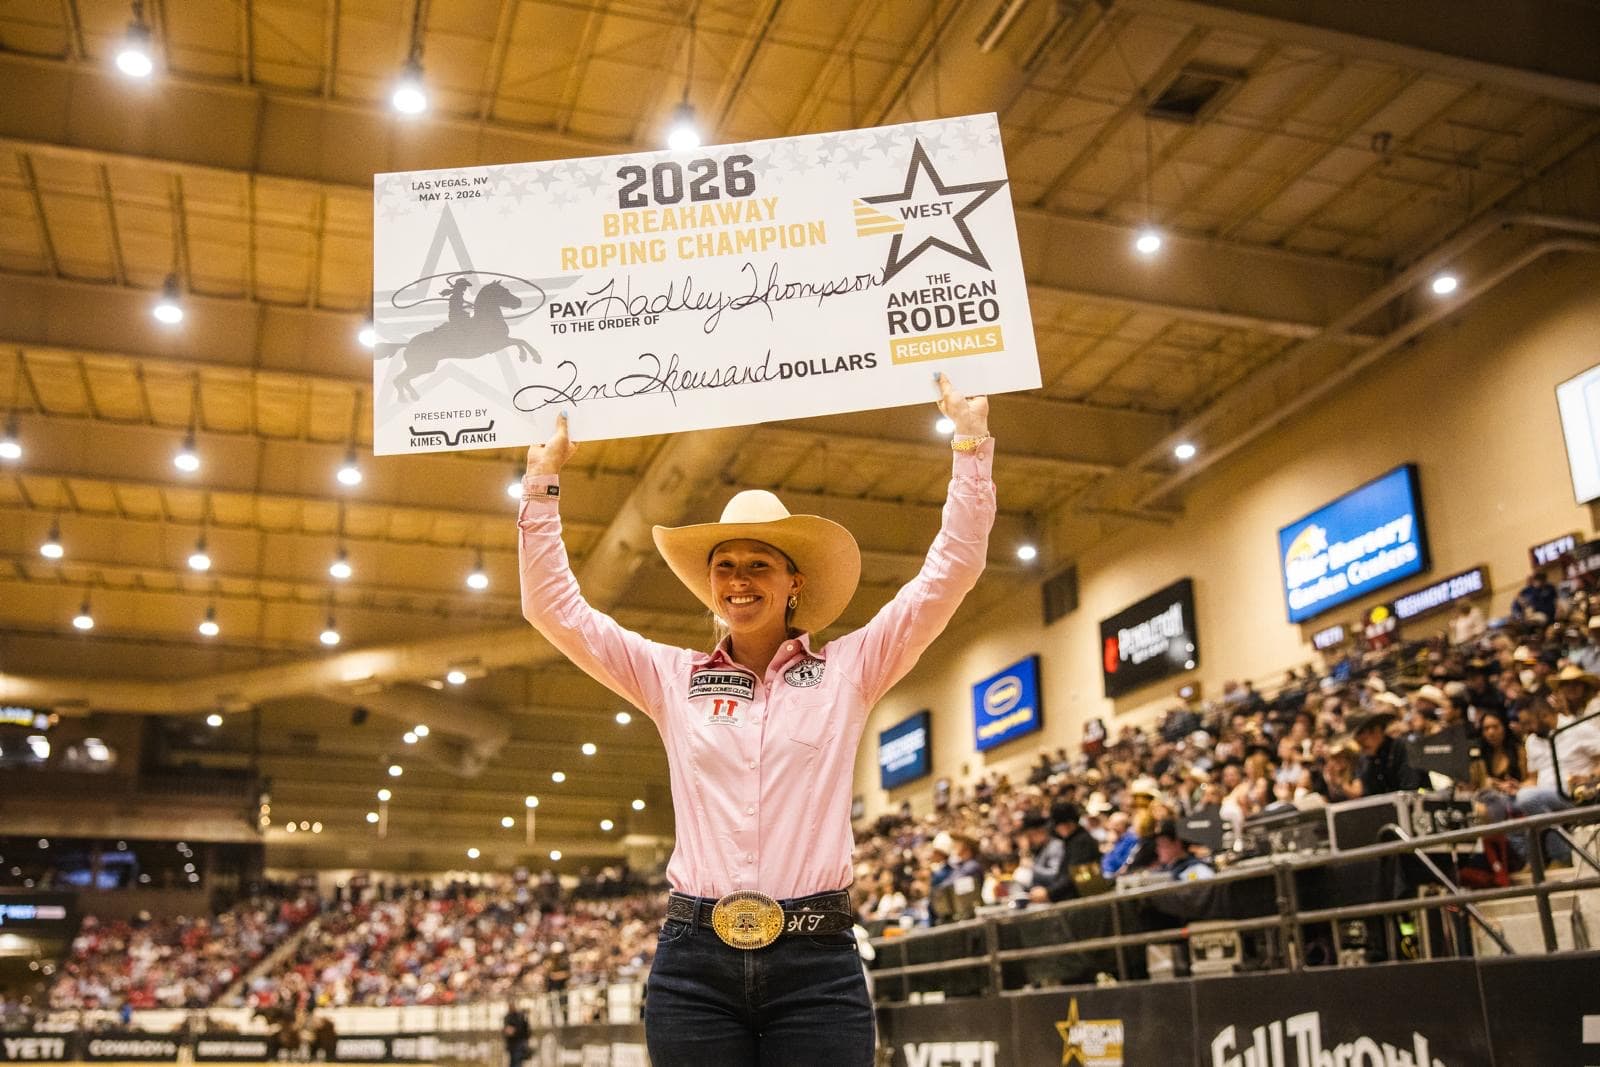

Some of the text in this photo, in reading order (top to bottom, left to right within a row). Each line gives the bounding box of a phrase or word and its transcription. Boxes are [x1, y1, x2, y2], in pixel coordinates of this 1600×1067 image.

[412, 177, 488, 191] LAS VEGAS, NV
[616, 154, 756, 209] 2026
[419, 190, 481, 202] MAY 2, 2026
[602, 196, 779, 238] BREAKAWAY
[900, 201, 954, 220] WEST
[561, 219, 828, 271] ROPING CHAMPION
[926, 272, 951, 285] THE
[587, 262, 886, 334] Hadley Thompson
[887, 279, 997, 309] AMERICAN
[550, 300, 588, 319] PAY
[887, 298, 1001, 335] RODEO
[551, 314, 660, 334] TO THE ORDER OF
[895, 332, 998, 359] REGIONALS
[779, 352, 878, 380] DOLLARS
[513, 349, 780, 412] Ten Thousand
[414, 408, 488, 422] PRESENTED BY
[410, 432, 496, 448] KIMES RANCH
[692, 675, 751, 688] RATTLER
[4, 1037, 65, 1060] YETI
